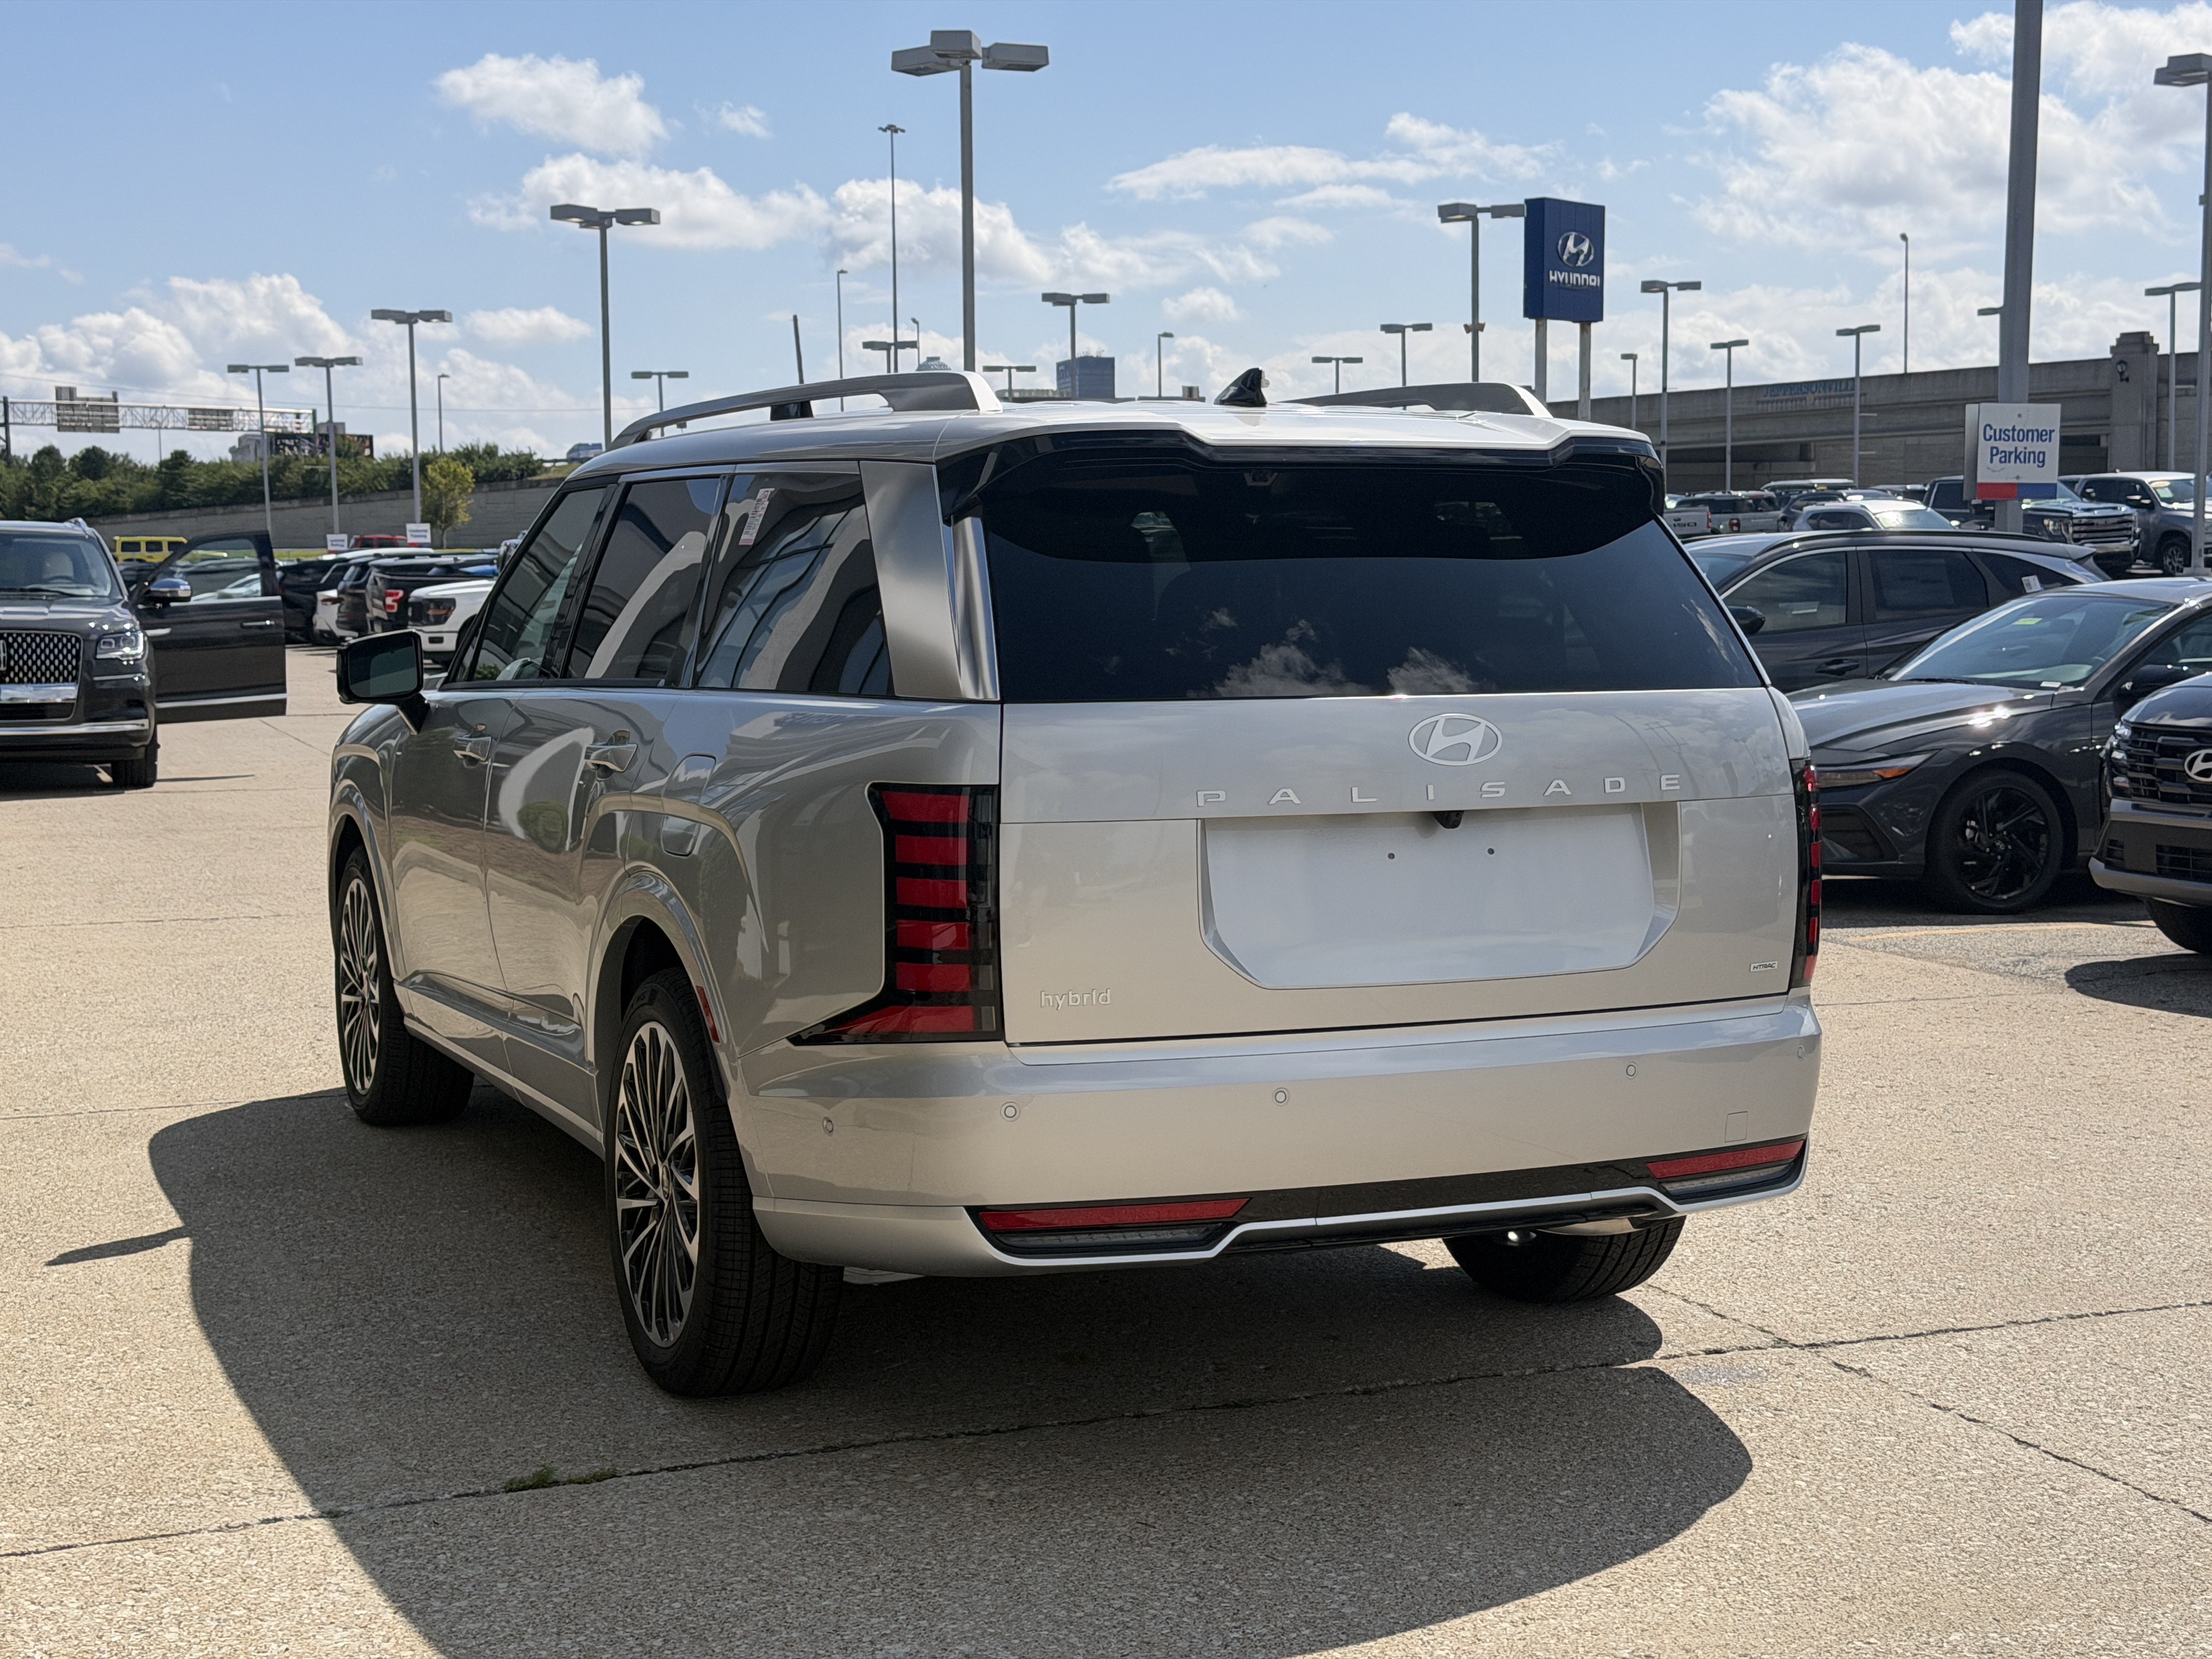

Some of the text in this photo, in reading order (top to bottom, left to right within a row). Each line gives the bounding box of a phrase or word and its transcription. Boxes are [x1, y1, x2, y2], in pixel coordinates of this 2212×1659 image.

[1549, 270, 1600, 286] HYUNDAI
[1983, 424, 2055, 443] Customer
[1990, 446, 2046, 468] Parking
[1197, 774, 1681, 807] PALISADE
[1041, 988, 1111, 1010] hybrid
